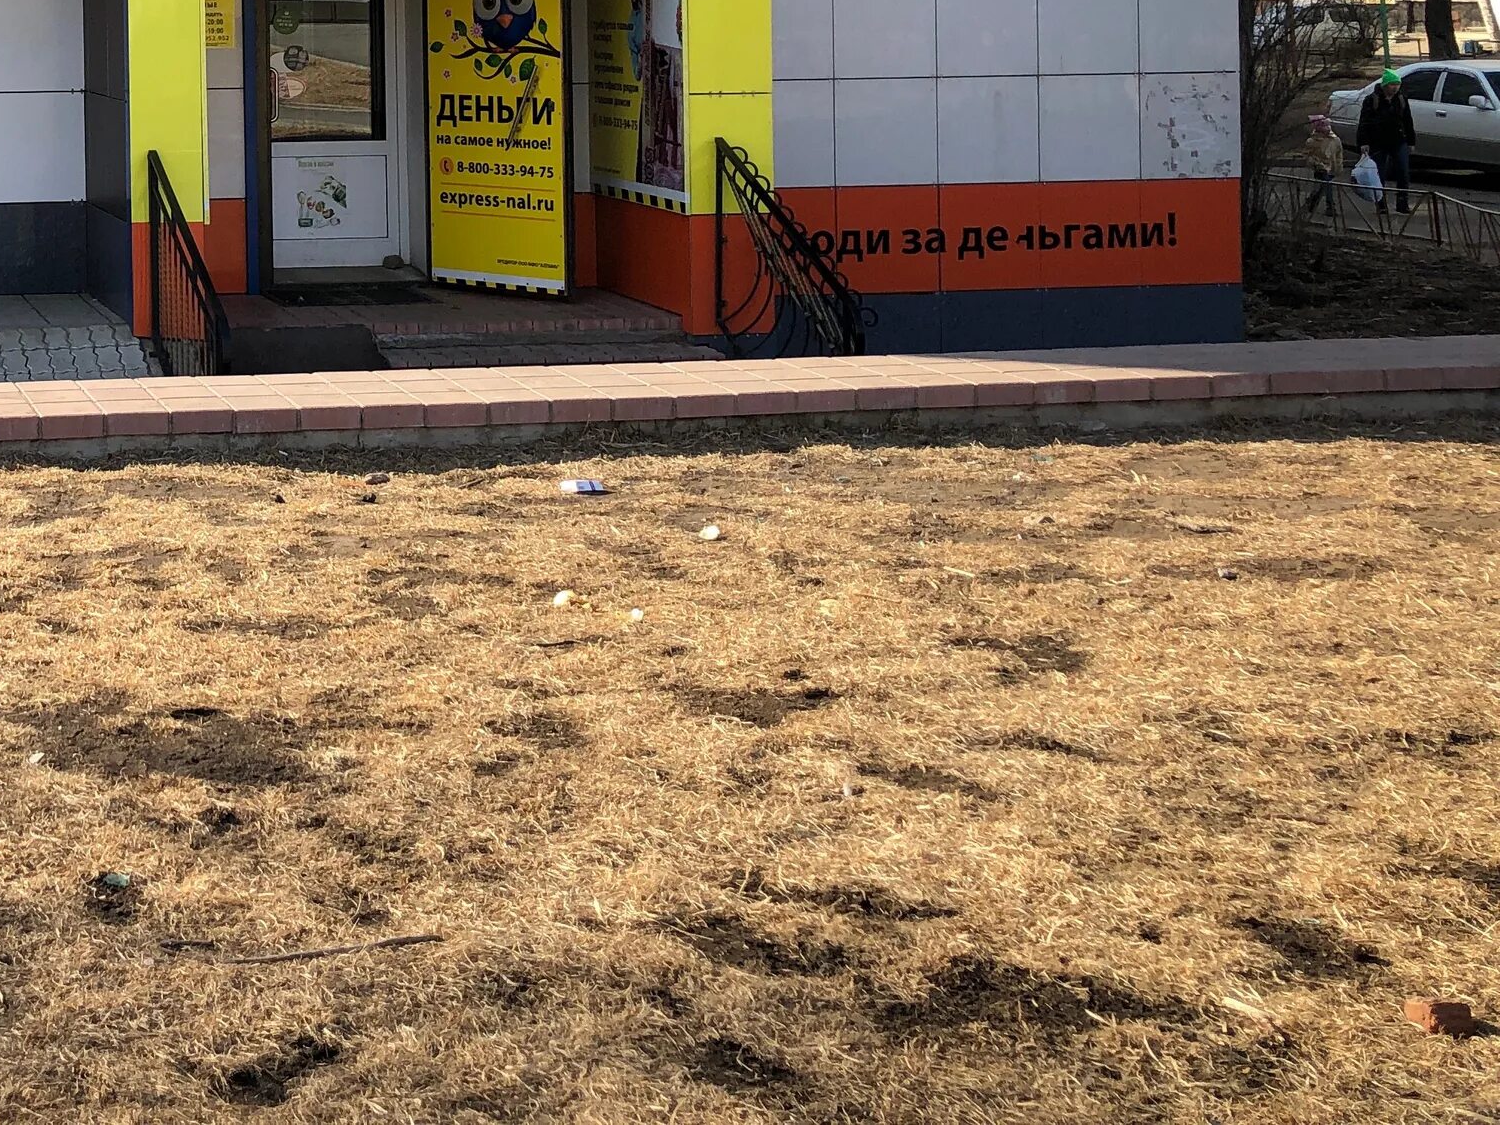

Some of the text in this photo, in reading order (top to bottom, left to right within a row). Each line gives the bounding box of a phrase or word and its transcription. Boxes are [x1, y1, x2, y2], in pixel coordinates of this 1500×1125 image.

[436, 134, 452, 145] на
[454, 135, 494, 148] самое
[457, 161, 555, 179] 8-800-333-94-75
[439, 191, 555, 212] express-nal.ru
[901, 227, 947, 255] за
[957, 211, 1178, 261] деньгами!
